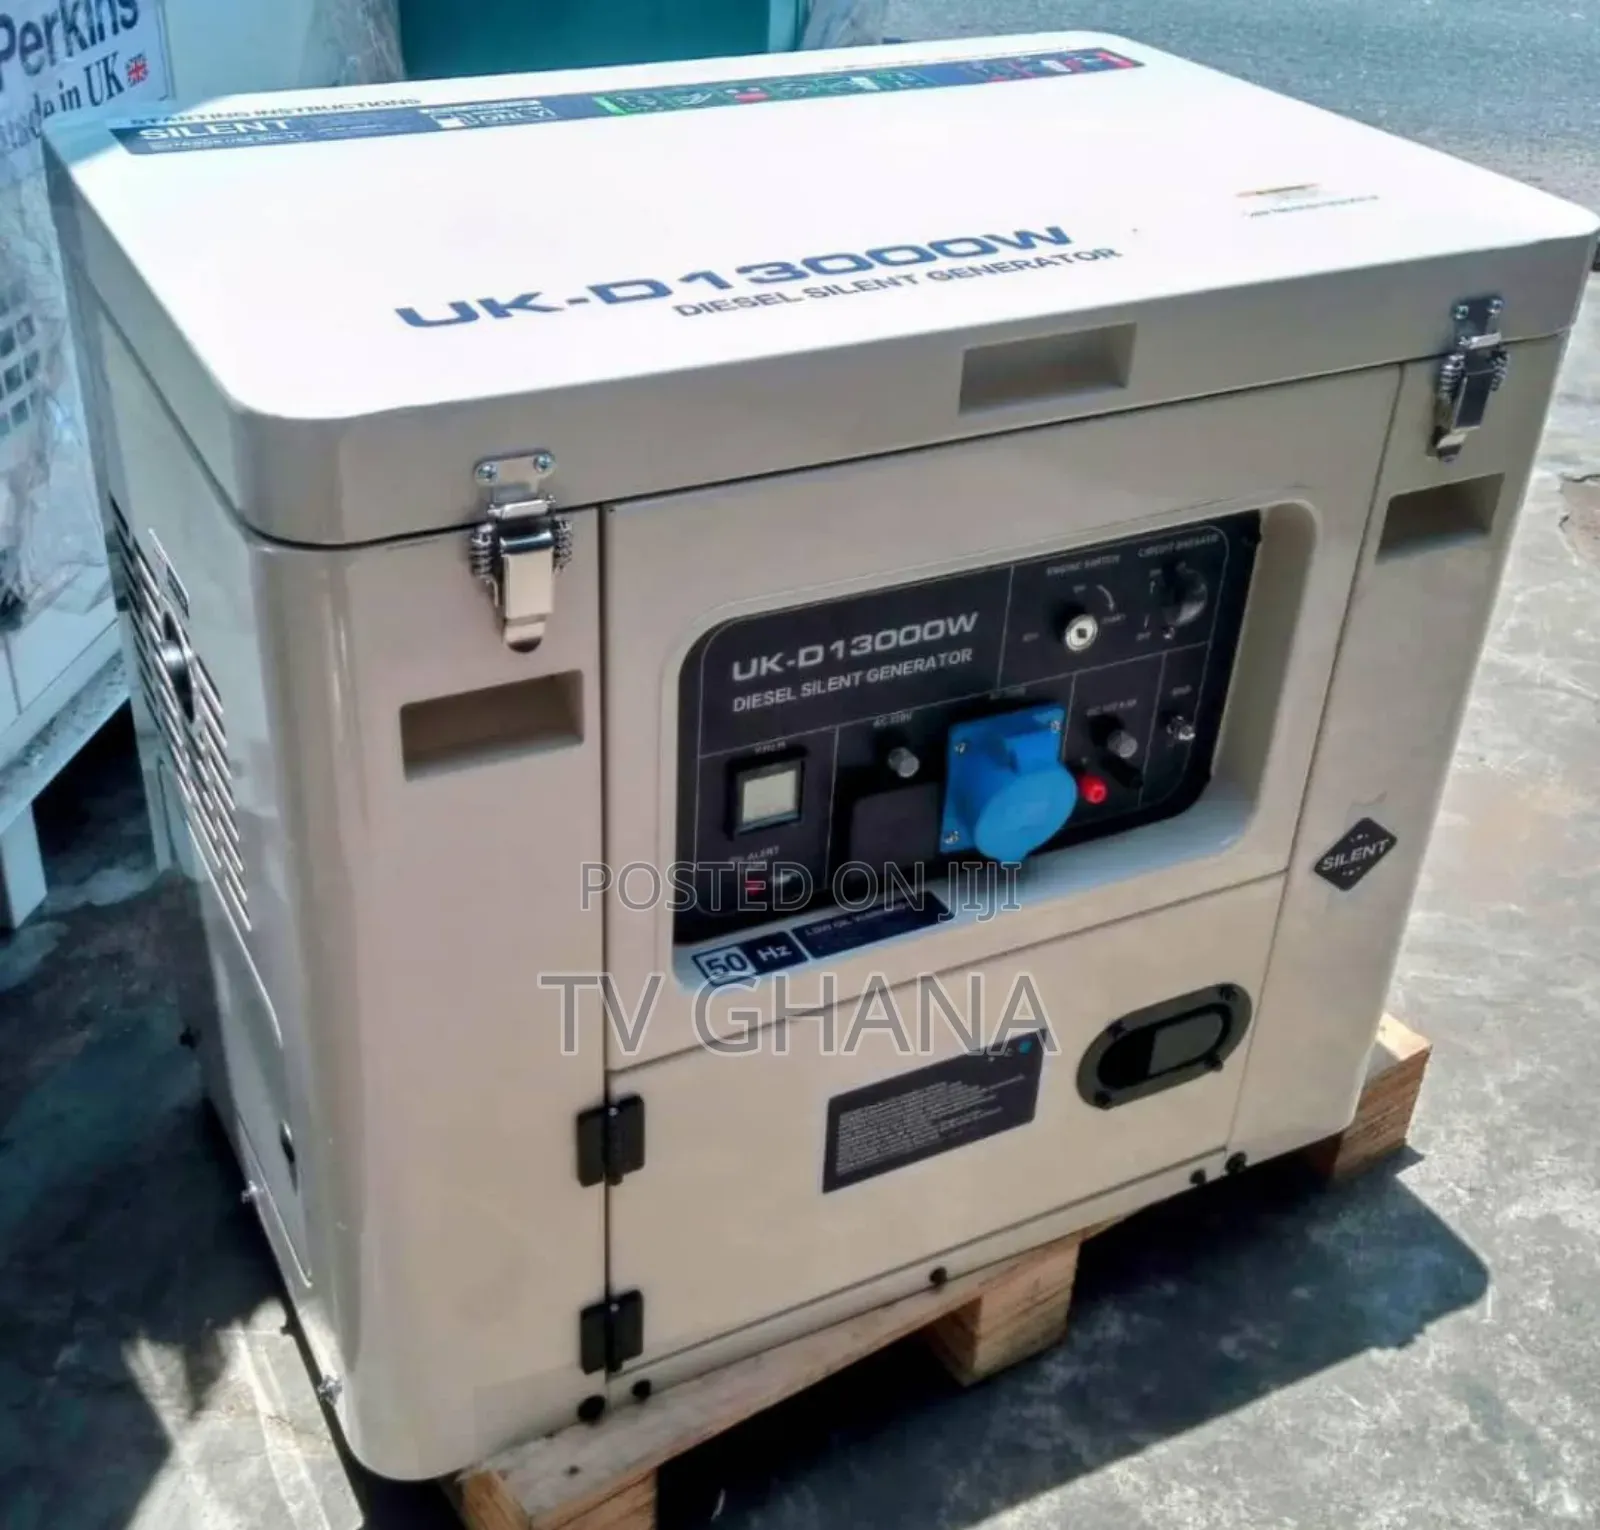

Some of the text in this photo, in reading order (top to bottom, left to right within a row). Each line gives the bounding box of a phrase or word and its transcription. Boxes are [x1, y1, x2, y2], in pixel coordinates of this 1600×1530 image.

[58, 80, 82, 112] in
[84, 51, 125, 107] UK
[138, 119, 293, 140] SILENT
[395, 226, 1073, 328] UK-D13000W
[673, 247, 1123, 317] DIESEL SILENT GENERATOR
[731, 612, 979, 682] UK-D13000W
[733, 648, 973, 713] DIESEL SILENT GENERATOR
[1321, 839, 1390, 871] SILENT
[707, 944, 793, 974] 50 Hz
